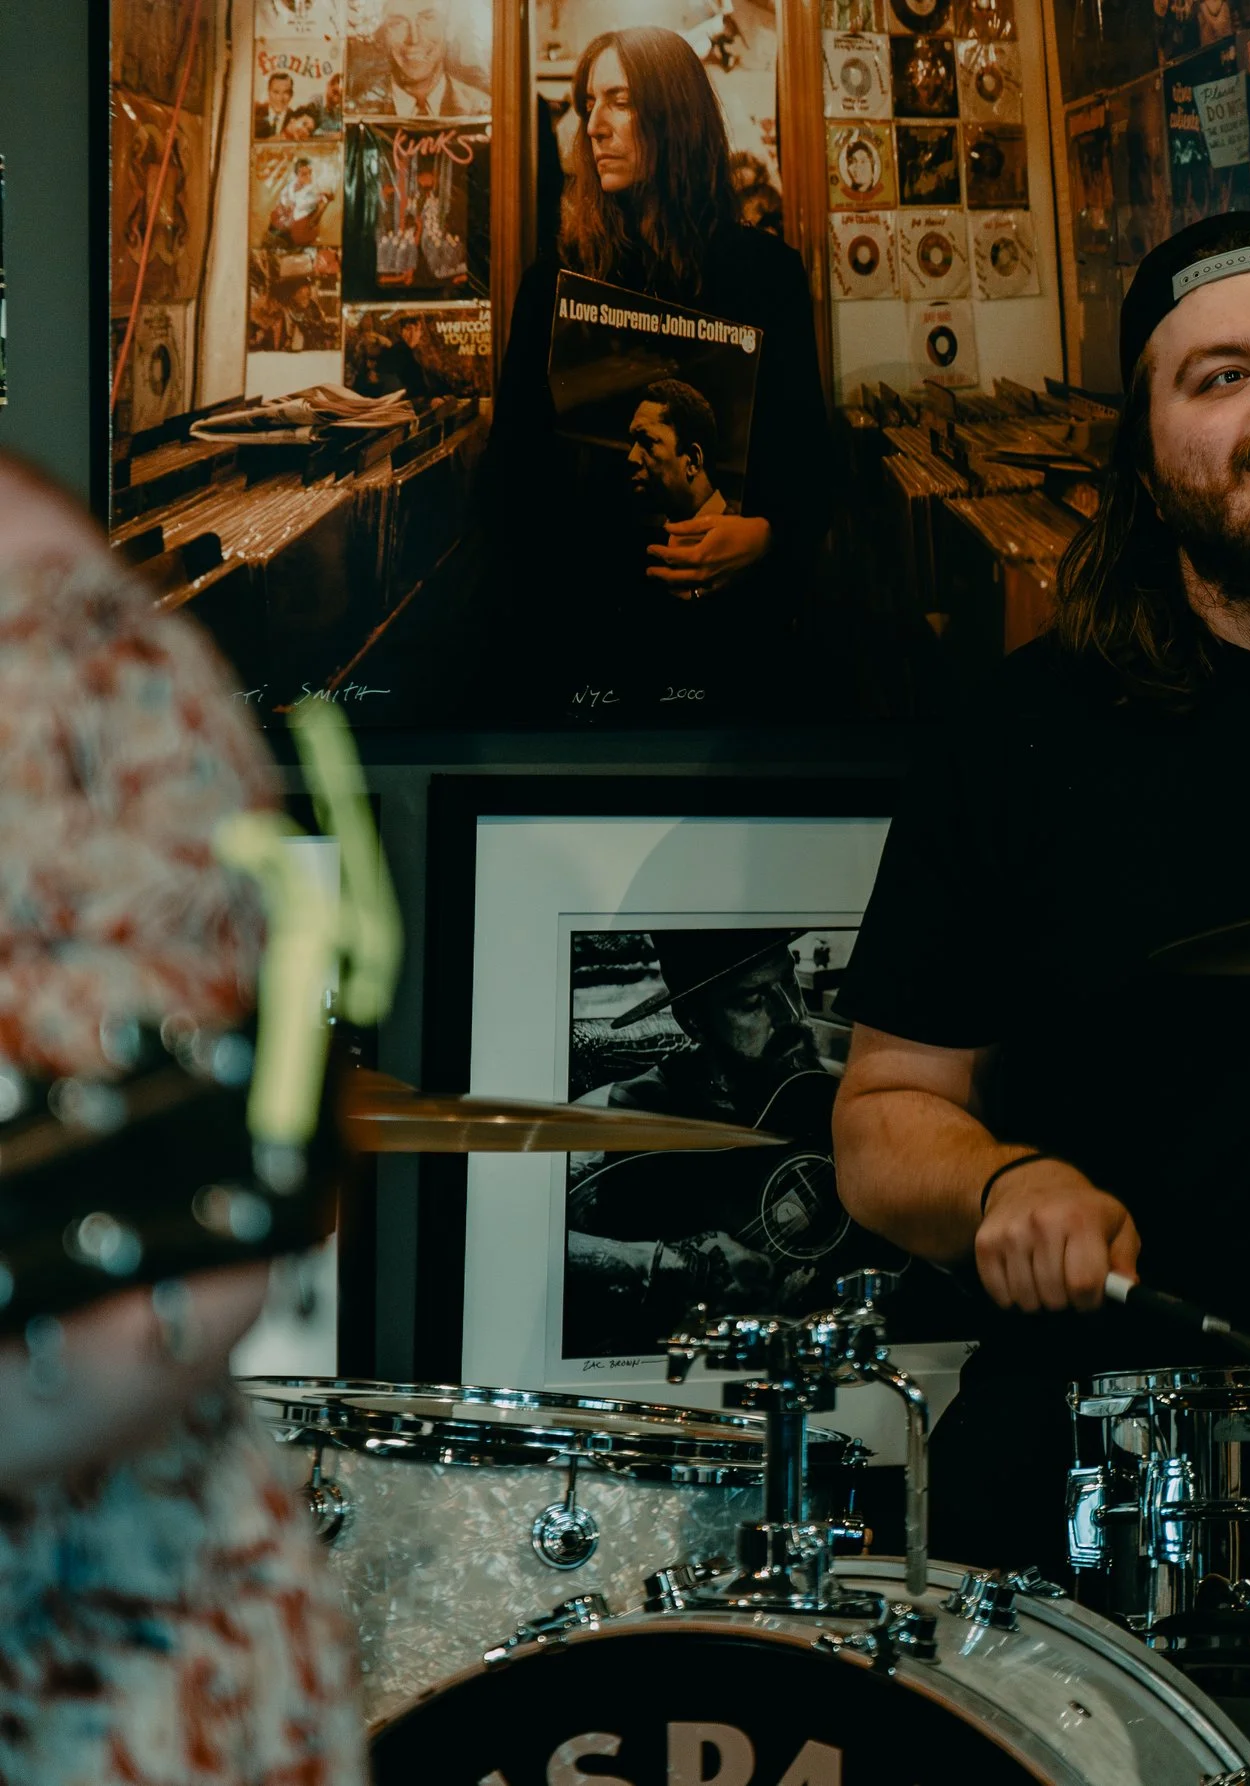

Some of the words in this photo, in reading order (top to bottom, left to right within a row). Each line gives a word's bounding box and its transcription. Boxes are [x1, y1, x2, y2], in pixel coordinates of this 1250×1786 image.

[257, 51, 333, 79] frankie
[559, 298, 567, 319] A
[569, 299, 598, 323] Love
[458, 343, 475, 356] ME
[572, 685, 620, 707] NYC
[659, 687, 705, 702] 2000
